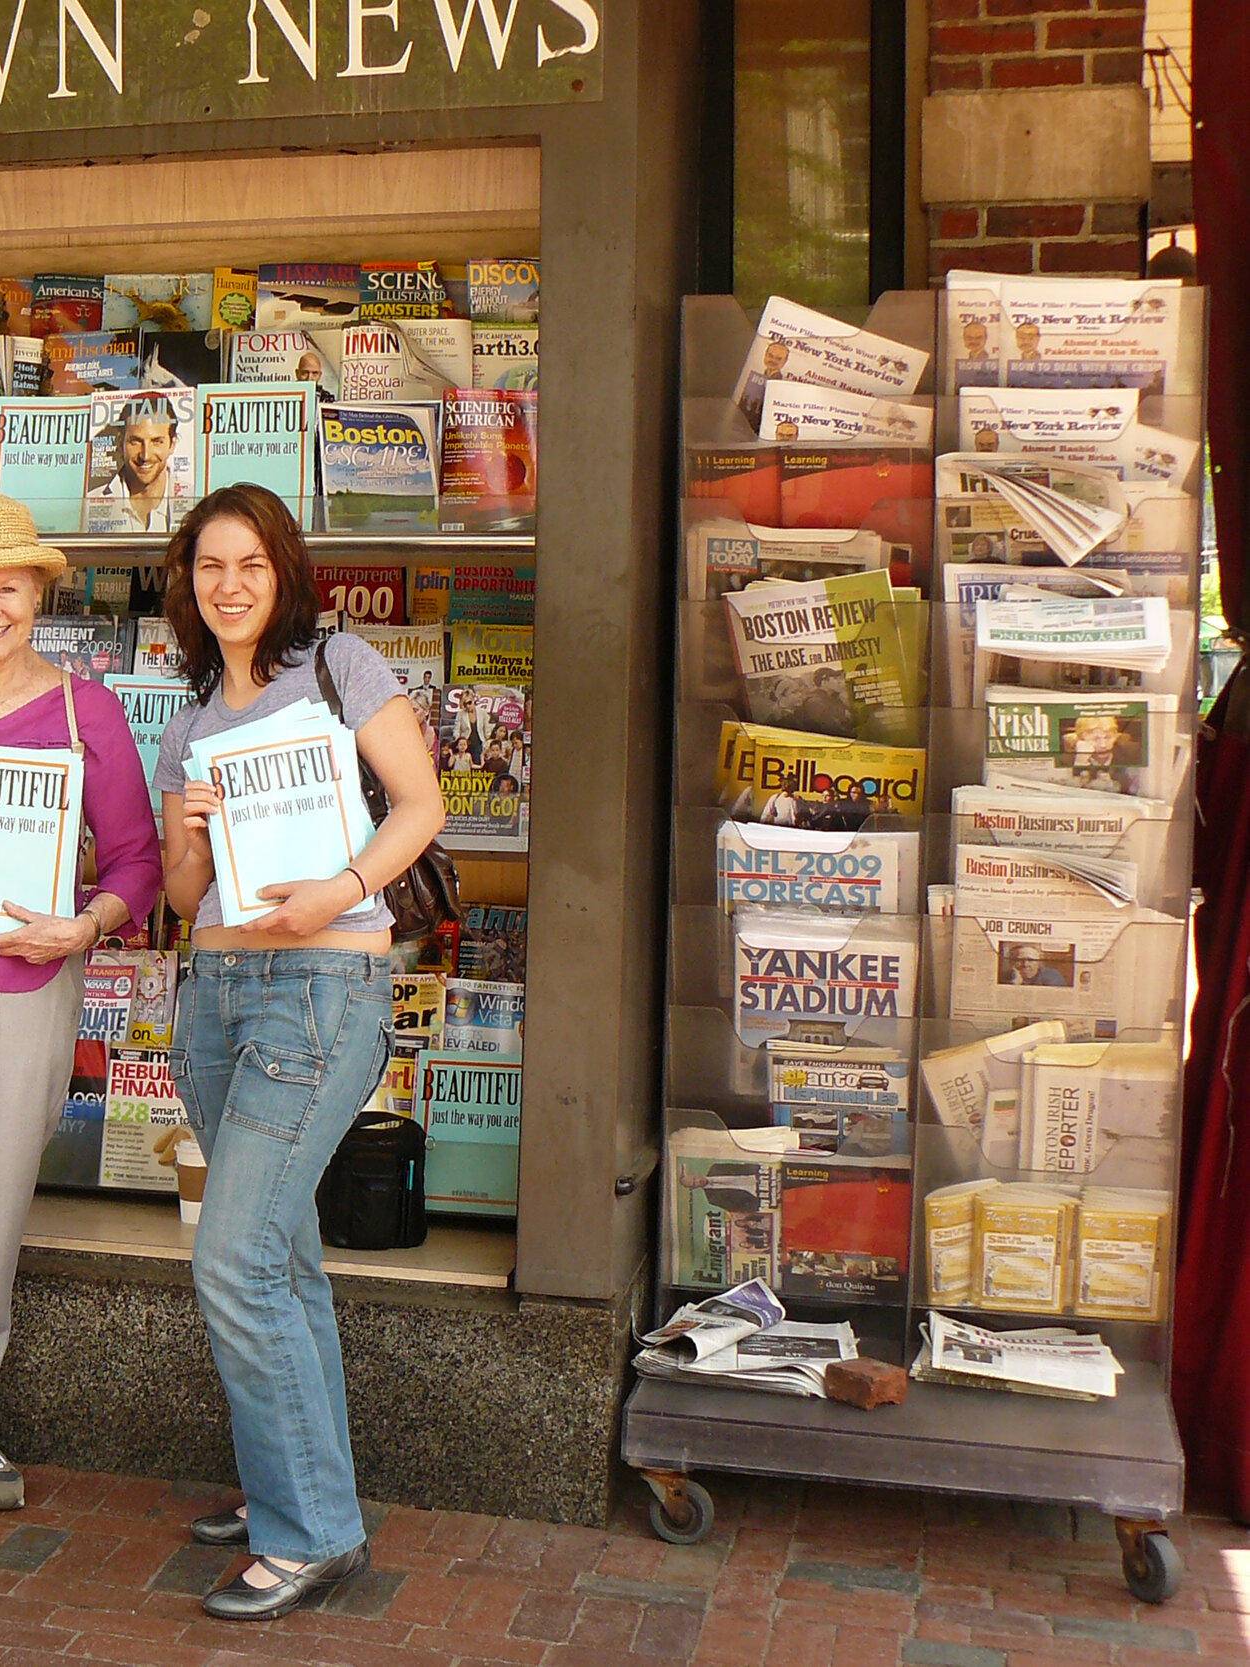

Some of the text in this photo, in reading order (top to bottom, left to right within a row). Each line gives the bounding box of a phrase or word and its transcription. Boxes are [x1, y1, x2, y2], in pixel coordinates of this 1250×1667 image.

[238, 0, 600, 84] NEWS
[377, 290, 446, 301] ILLUSTRATED
[470, 287, 502, 297] ENERGY
[469, 295, 508, 305] WITHOUT
[361, 303, 439, 316] MONSTERS
[1012, 314, 1165, 324] The New York Review
[44, 338, 135, 359] Smithsonian
[1062, 339, 1098, 347] Ahmed
[769, 330, 904, 386] The New York Review
[1044, 347, 1090, 355] Pakistan
[236, 354, 286, 364] Amazon's
[236, 364, 260, 374] Next
[359, 364, 389, 375] Your
[235, 373, 291, 383] Revolution
[358, 388, 394, 400] Brain
[91, 397, 195, 427] DETAILS
[446, 401, 515, 414] SCIENTIFIC
[201, 400, 309, 434] BEAUTIFUL
[446, 415, 514, 427] AMERICAN
[324, 420, 423, 445] Boston
[445, 432, 479, 441] Unlikely
[444, 441, 530, 450] Improbable Planets
[784, 455, 828, 465] Learning
[724, 540, 753, 554] USA
[709, 552, 755, 566] TODAY
[329, 586, 395, 619] 100
[742, 598, 876, 641] BOSTON REVIEW
[1065, 630, 1094, 642] VAN
[80, 641, 113, 654] 2009
[477, 654, 522, 666] 11 Ways
[750, 637, 882, 673] THE CASE FOR AMNESTY
[989, 705, 1050, 737] Irish
[989, 738, 1050, 753] EXAMINER
[207, 745, 342, 801] BEAUTIFUL
[761, 757, 918, 801] Billboard
[441, 777, 493, 793] DADDY
[230, 794, 334, 827] just the way you are
[490, 797, 519, 816] GO!
[18, 818, 35, 833] you
[38, 819, 56, 834] are
[974, 812, 1123, 834] Boston Business Journal
[727, 849, 882, 878] NFL 2009
[728, 879, 882, 907] FORECAST
[983, 920, 1052, 935] JOB CRUNCH
[741, 948, 900, 982] YANKEE
[474, 983, 515, 992] FANTASTIC
[740, 982, 898, 1017] STADIUM
[478, 1009, 513, 1026] Vista
[808, 1061, 859, 1069] THOUSANDS
[806, 1072, 859, 1086] auto
[107, 1101, 183, 1122] 328 smart
[1049, 1087, 1062, 1122] IRISH
[151, 1116, 190, 1126] ways to
[787, 1168, 829, 1178] Learning
[700, 1210, 722, 1284] Emigrant
[826, 1280, 875, 1291] don Quijote
